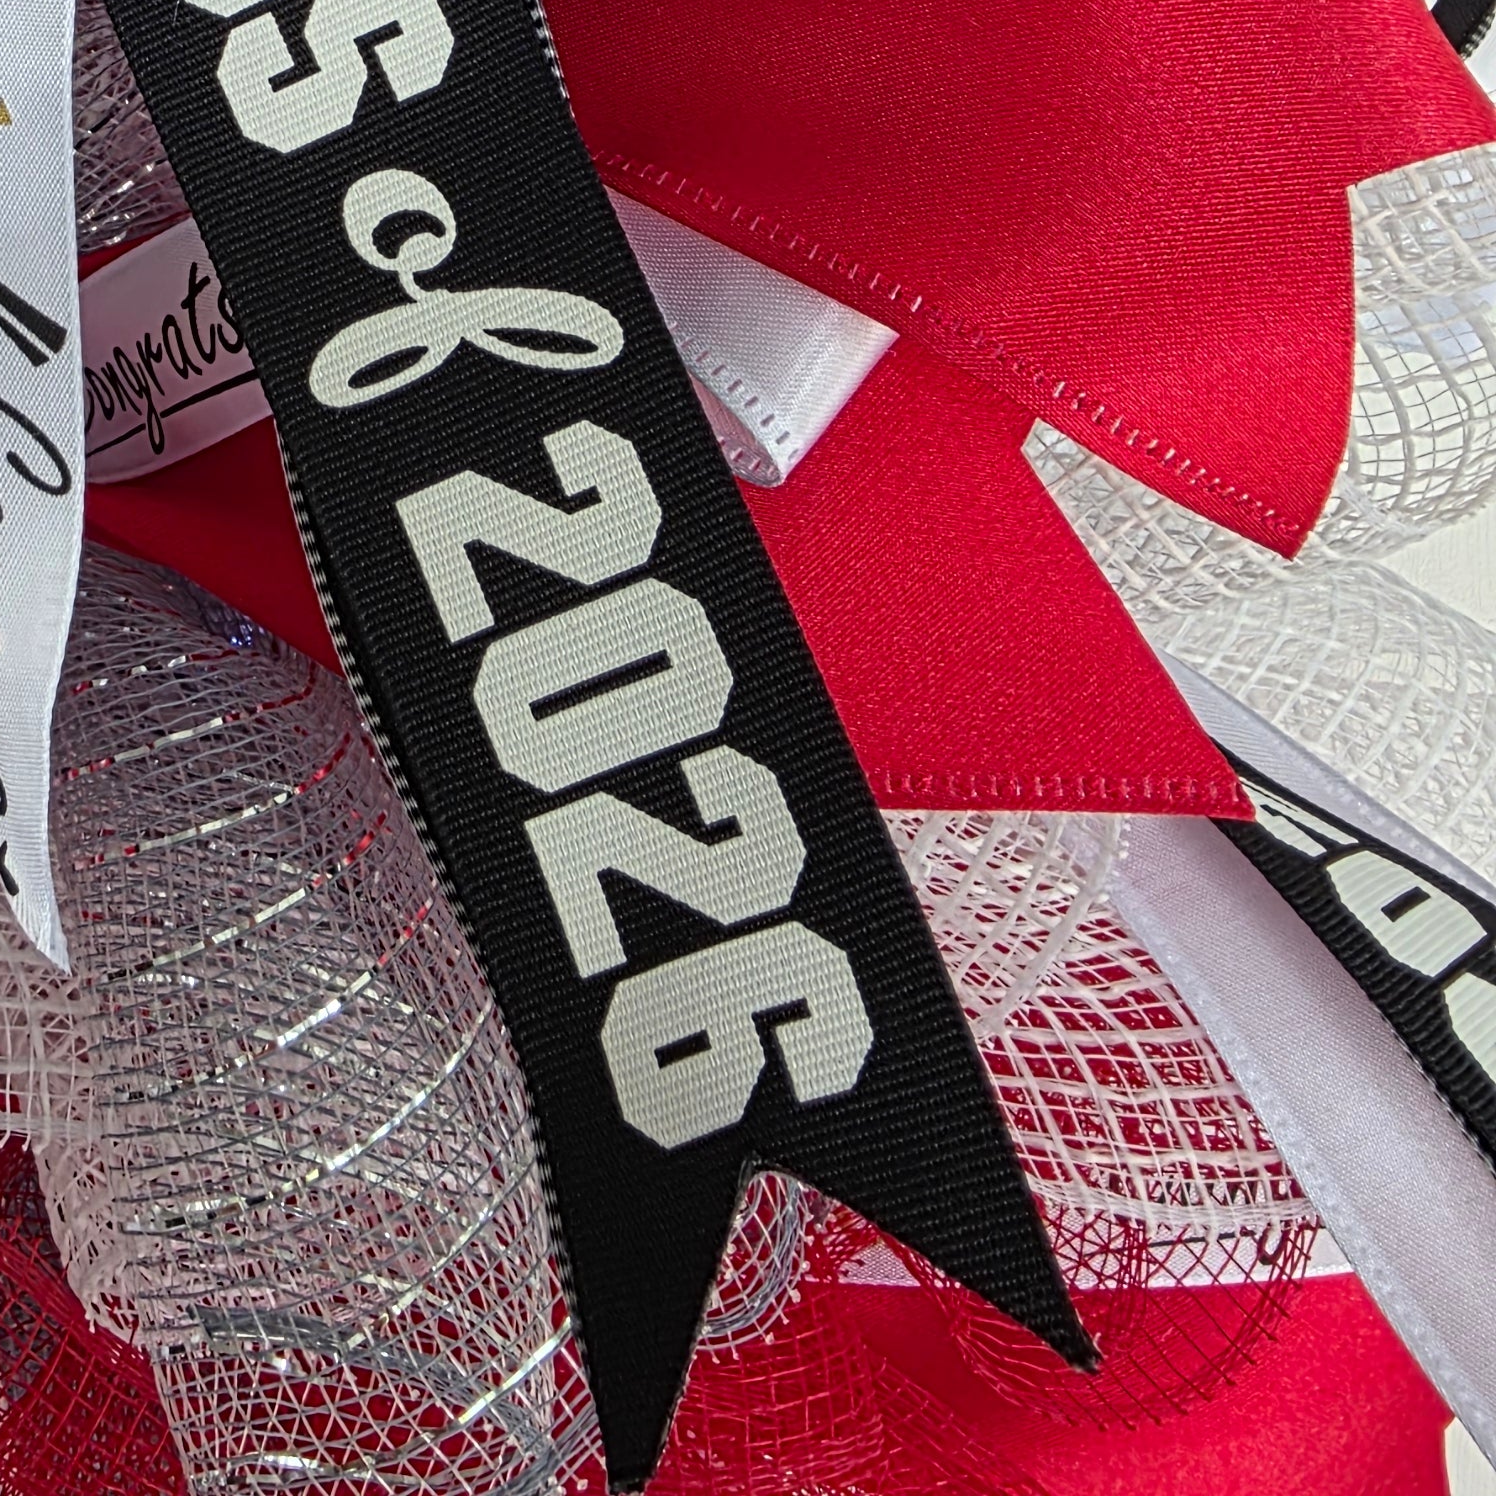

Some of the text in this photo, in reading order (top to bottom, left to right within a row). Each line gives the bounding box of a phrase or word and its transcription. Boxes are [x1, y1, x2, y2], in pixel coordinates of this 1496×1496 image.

[84, 261, 244, 455] ongrats
[308, 168, 625, 408] of
[395, 419, 873, 1150] 2026
